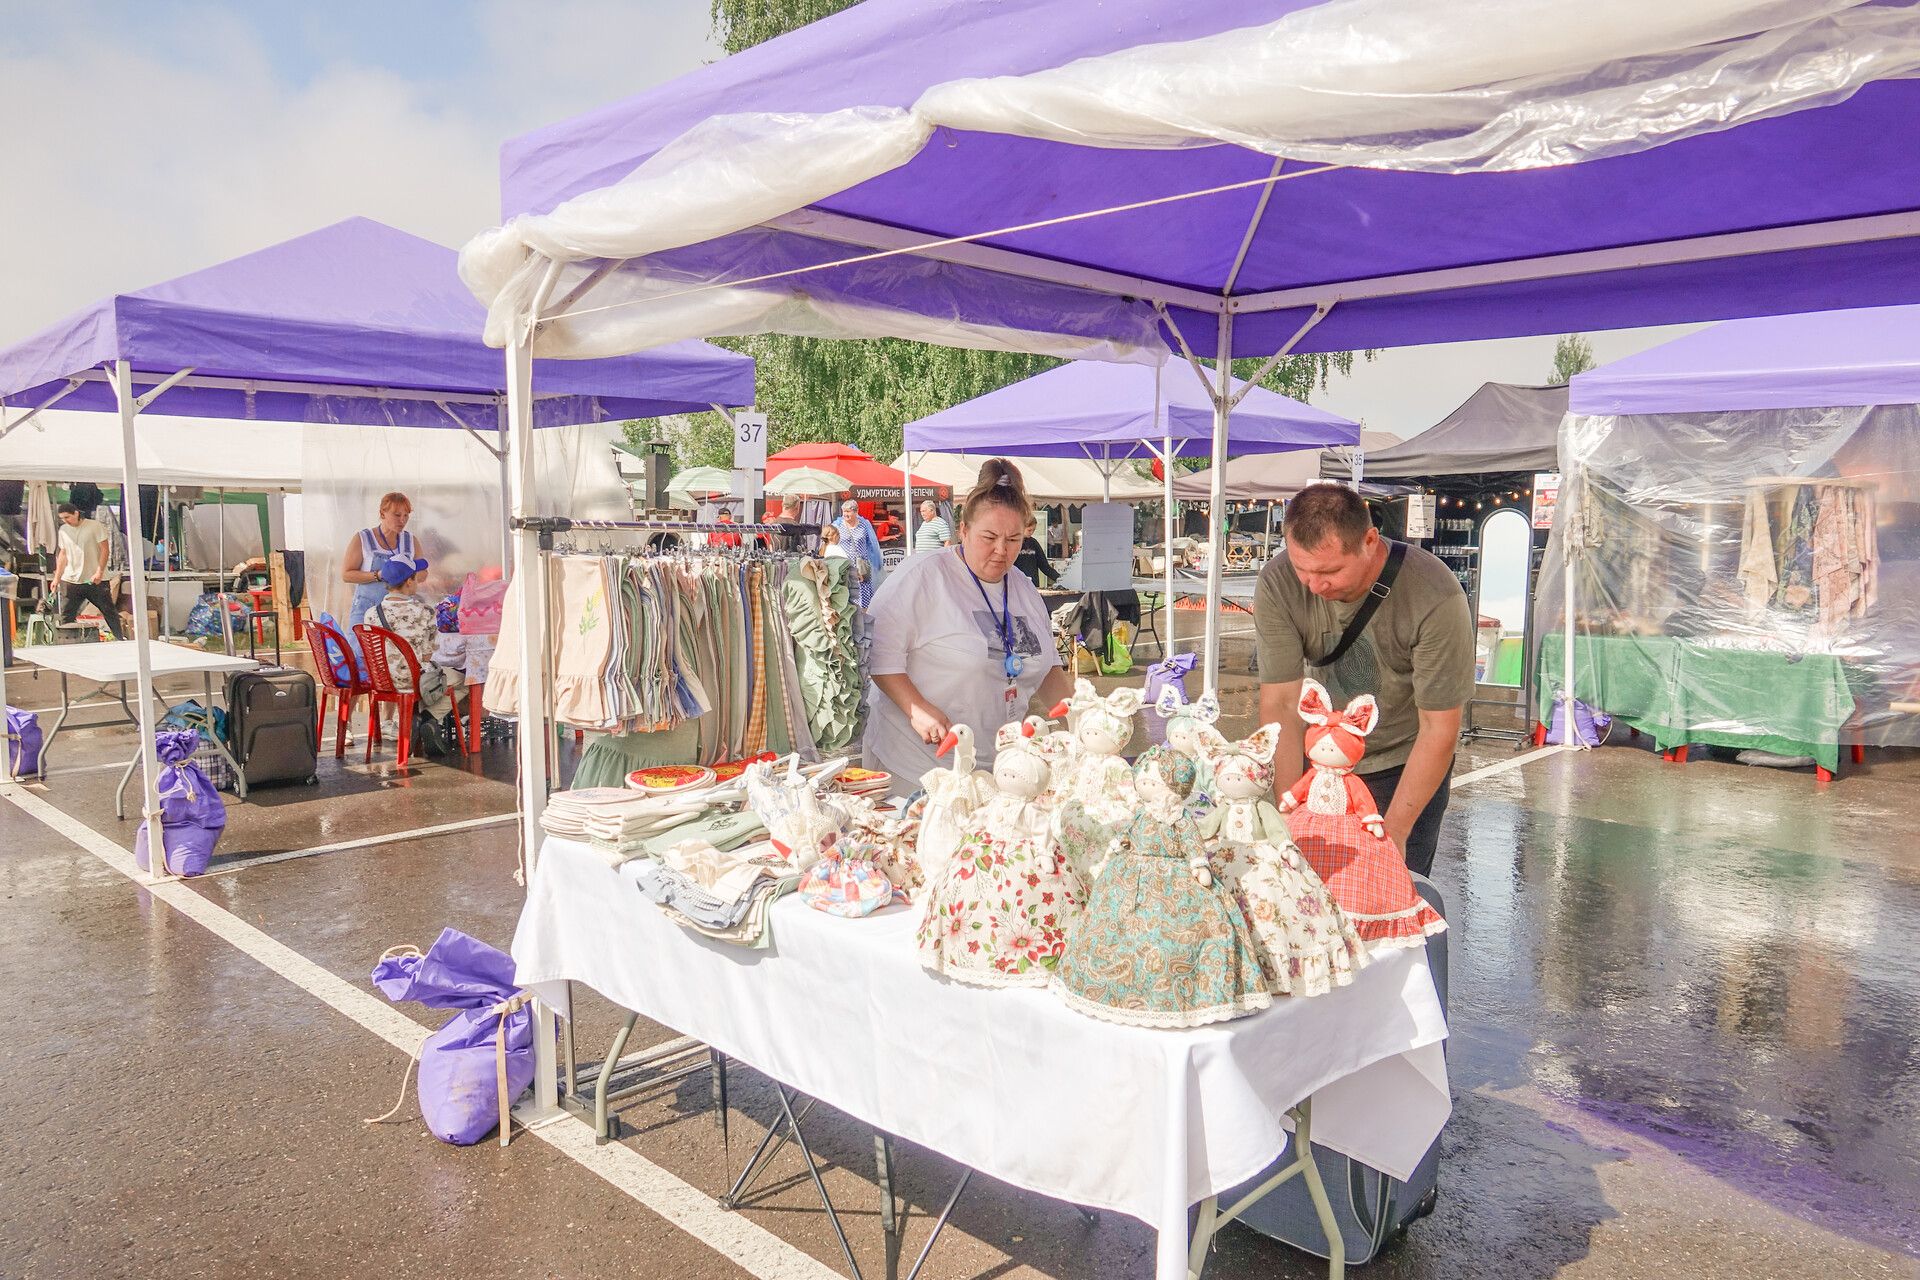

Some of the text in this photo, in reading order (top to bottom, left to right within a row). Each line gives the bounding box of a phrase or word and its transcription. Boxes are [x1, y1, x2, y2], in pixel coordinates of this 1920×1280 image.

[740, 423, 762, 443] 37
[1354, 454, 1363, 466] 35
[857, 488, 934, 498] УДМУРТСКИЕ ПРЕПЕЧИ
